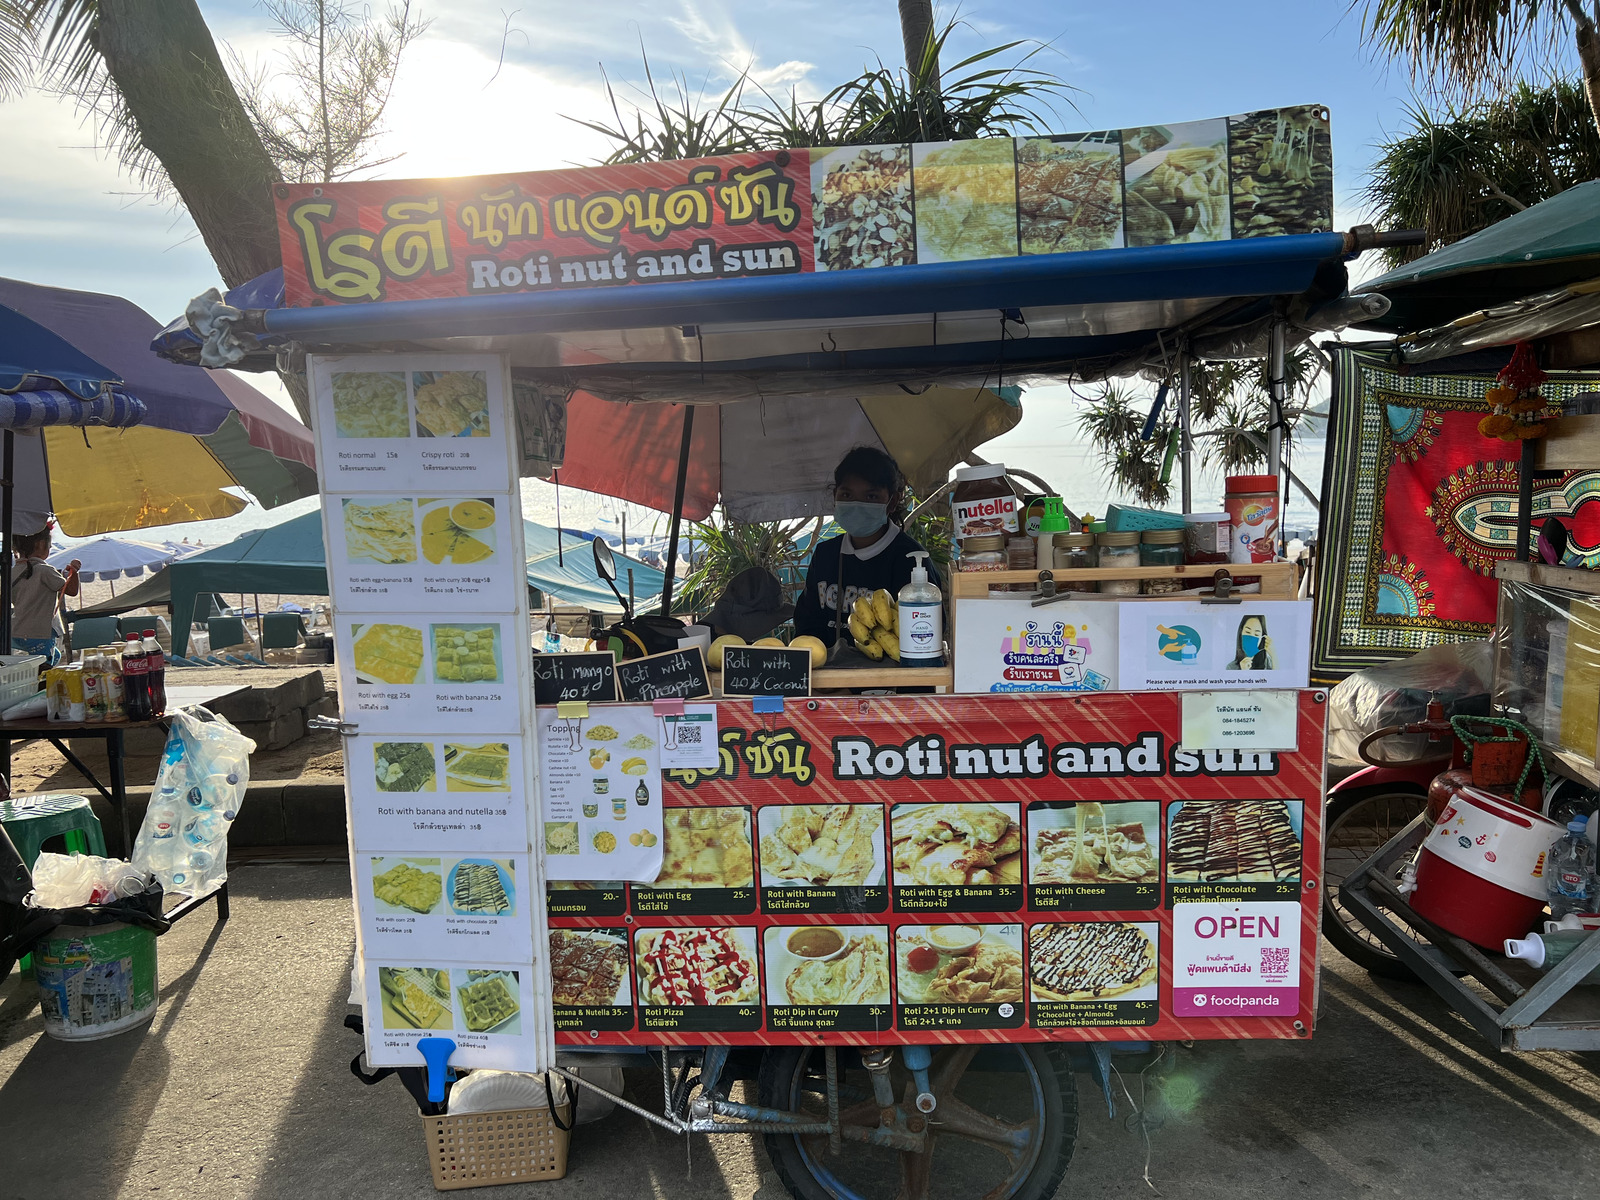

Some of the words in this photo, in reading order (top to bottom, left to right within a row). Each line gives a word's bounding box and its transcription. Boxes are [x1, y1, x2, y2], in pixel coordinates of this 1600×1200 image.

[294, 197, 446, 300] โรตี
[462, 188, 538, 246] นัท
[555, 171, 716, 242] แอนด์
[721, 167, 795, 225] ซัน
[473, 256, 551, 289] Roti
[561, 249, 627, 283] nut
[637, 245, 713, 280] and
[723, 244, 796, 273] sun
[958, 499, 1014, 519] nutella
[726, 651, 750, 669] Roti
[763, 653, 791, 669] with
[622, 665, 649, 687] Roti
[661, 654, 692, 674] with
[572, 667, 613, 691] mango
[639, 674, 703, 700] Pineapple
[764, 673, 808, 690] Coconut
[547, 725, 581, 734] Topping
[837, 741, 941, 776] Roti
[956, 738, 1044, 774] nut
[1057, 737, 1161, 773] and
[378, 807, 394, 815] Roti
[416, 807, 446, 815] banana
[676, 892, 691, 900] Egg
[938, 889, 953, 897] Egg
[1036, 887, 1052, 895] Roti
[1194, 916, 1280, 938] OPEN
[1187, 963, 1252, 977] ฟู้ดแพนด้ามีส่ง
[1211, 994, 1280, 1009] foodpanda
[578, 1008, 584, 1016] &
[586, 1008, 610, 1016] Nutella
[612, 1008, 628, 1016] 35.-
[791, 1008, 805, 1018] Dip
[818, 1008, 839, 1017] Curry
[942, 1007, 955, 1015] Dip
[968, 1006, 989, 1014] Curry
